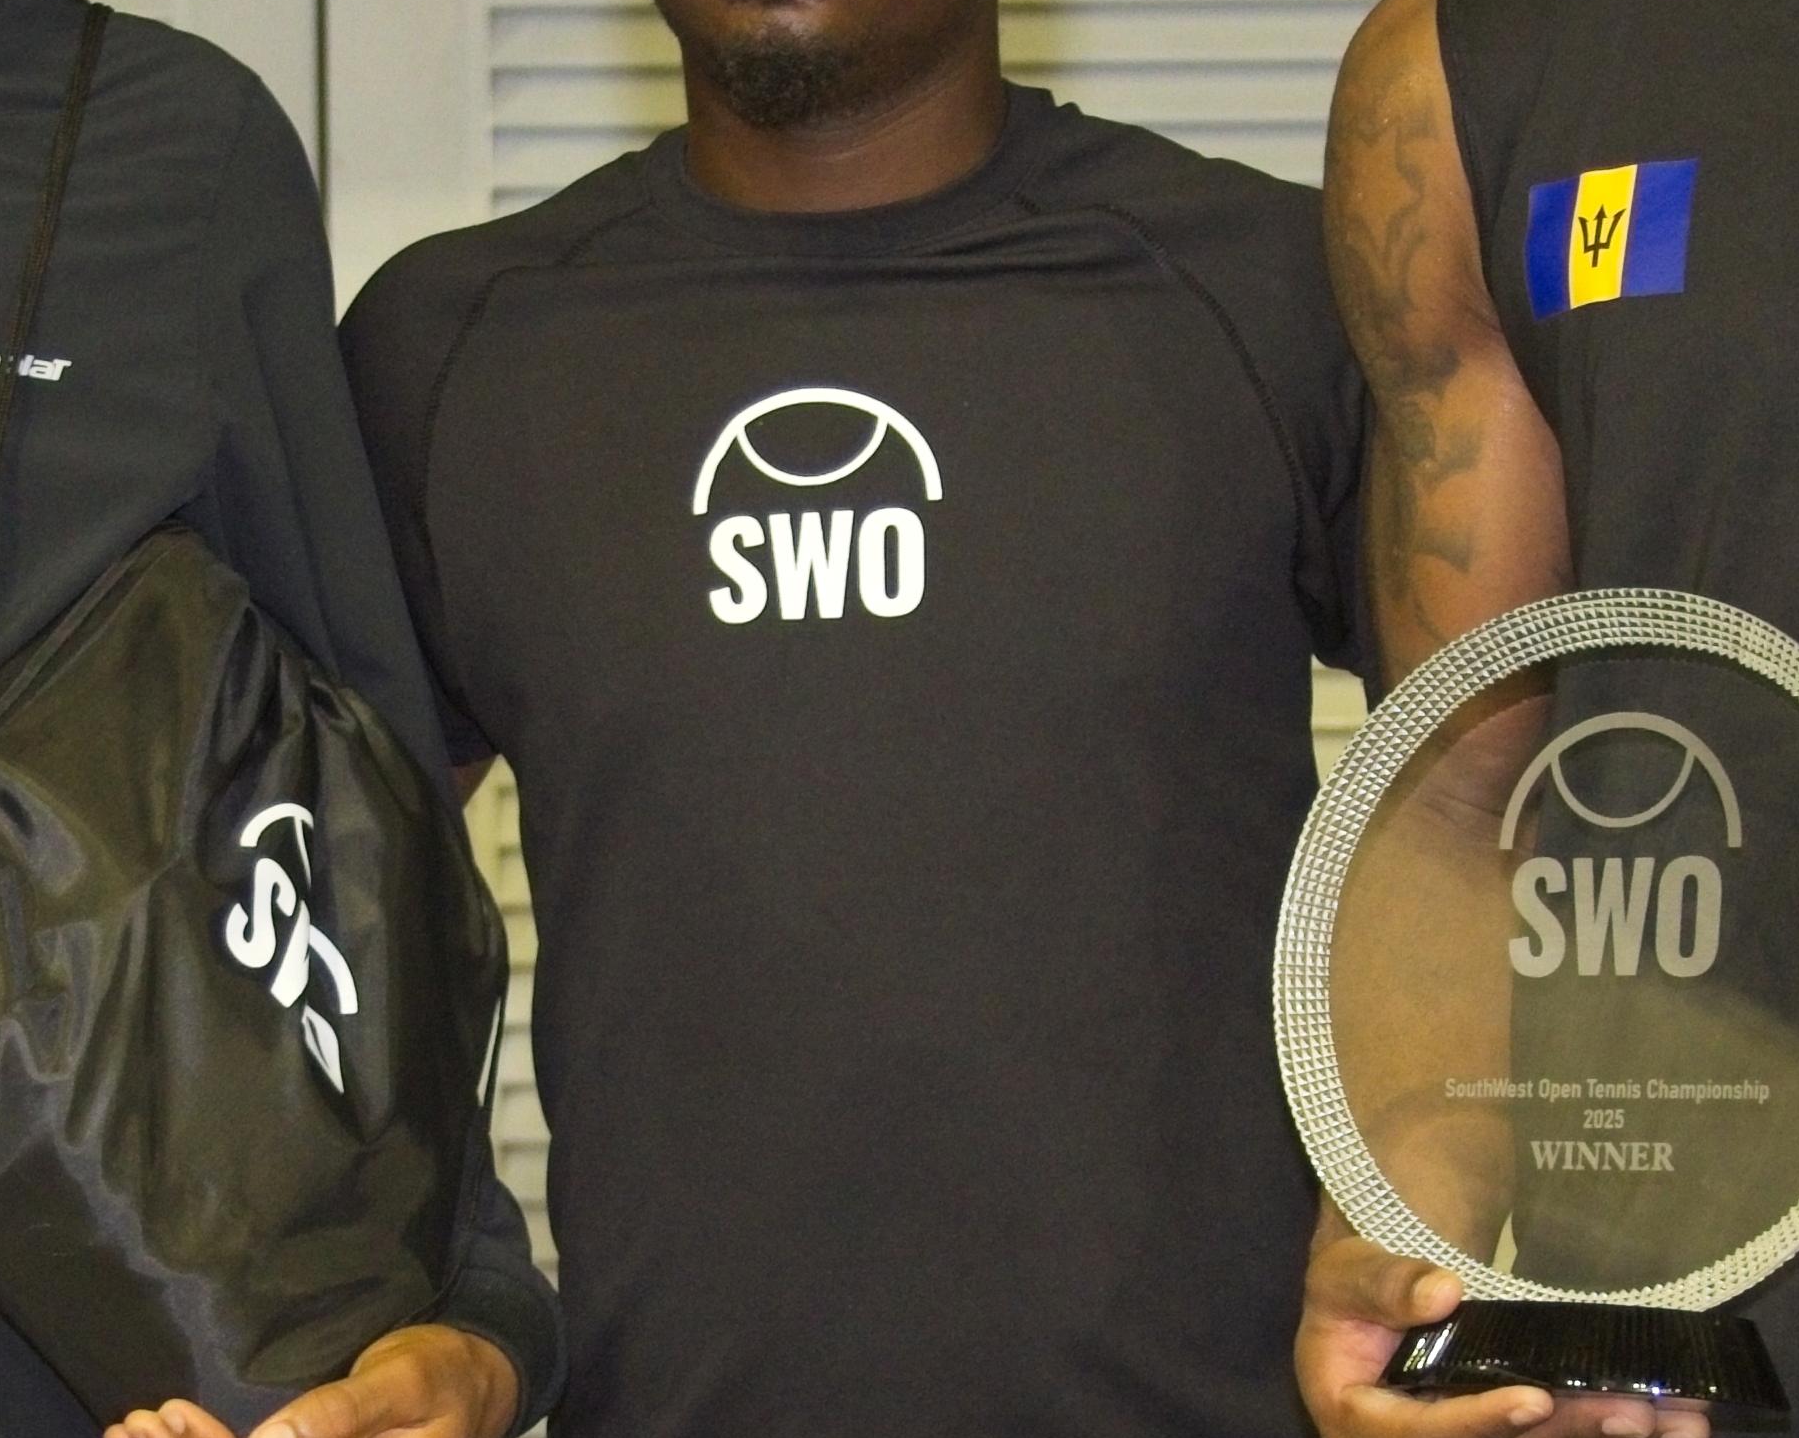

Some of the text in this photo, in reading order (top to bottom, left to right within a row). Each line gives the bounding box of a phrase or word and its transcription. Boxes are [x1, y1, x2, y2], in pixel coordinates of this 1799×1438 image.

[708, 506, 925, 624] SWO
[1508, 855, 1723, 979] SWO
[1444, 1078, 1770, 1104] SouthWest Open Tennis Championship
[1583, 1109, 1625, 1129] 2025
[1530, 1140, 1675, 1172] WINNER
